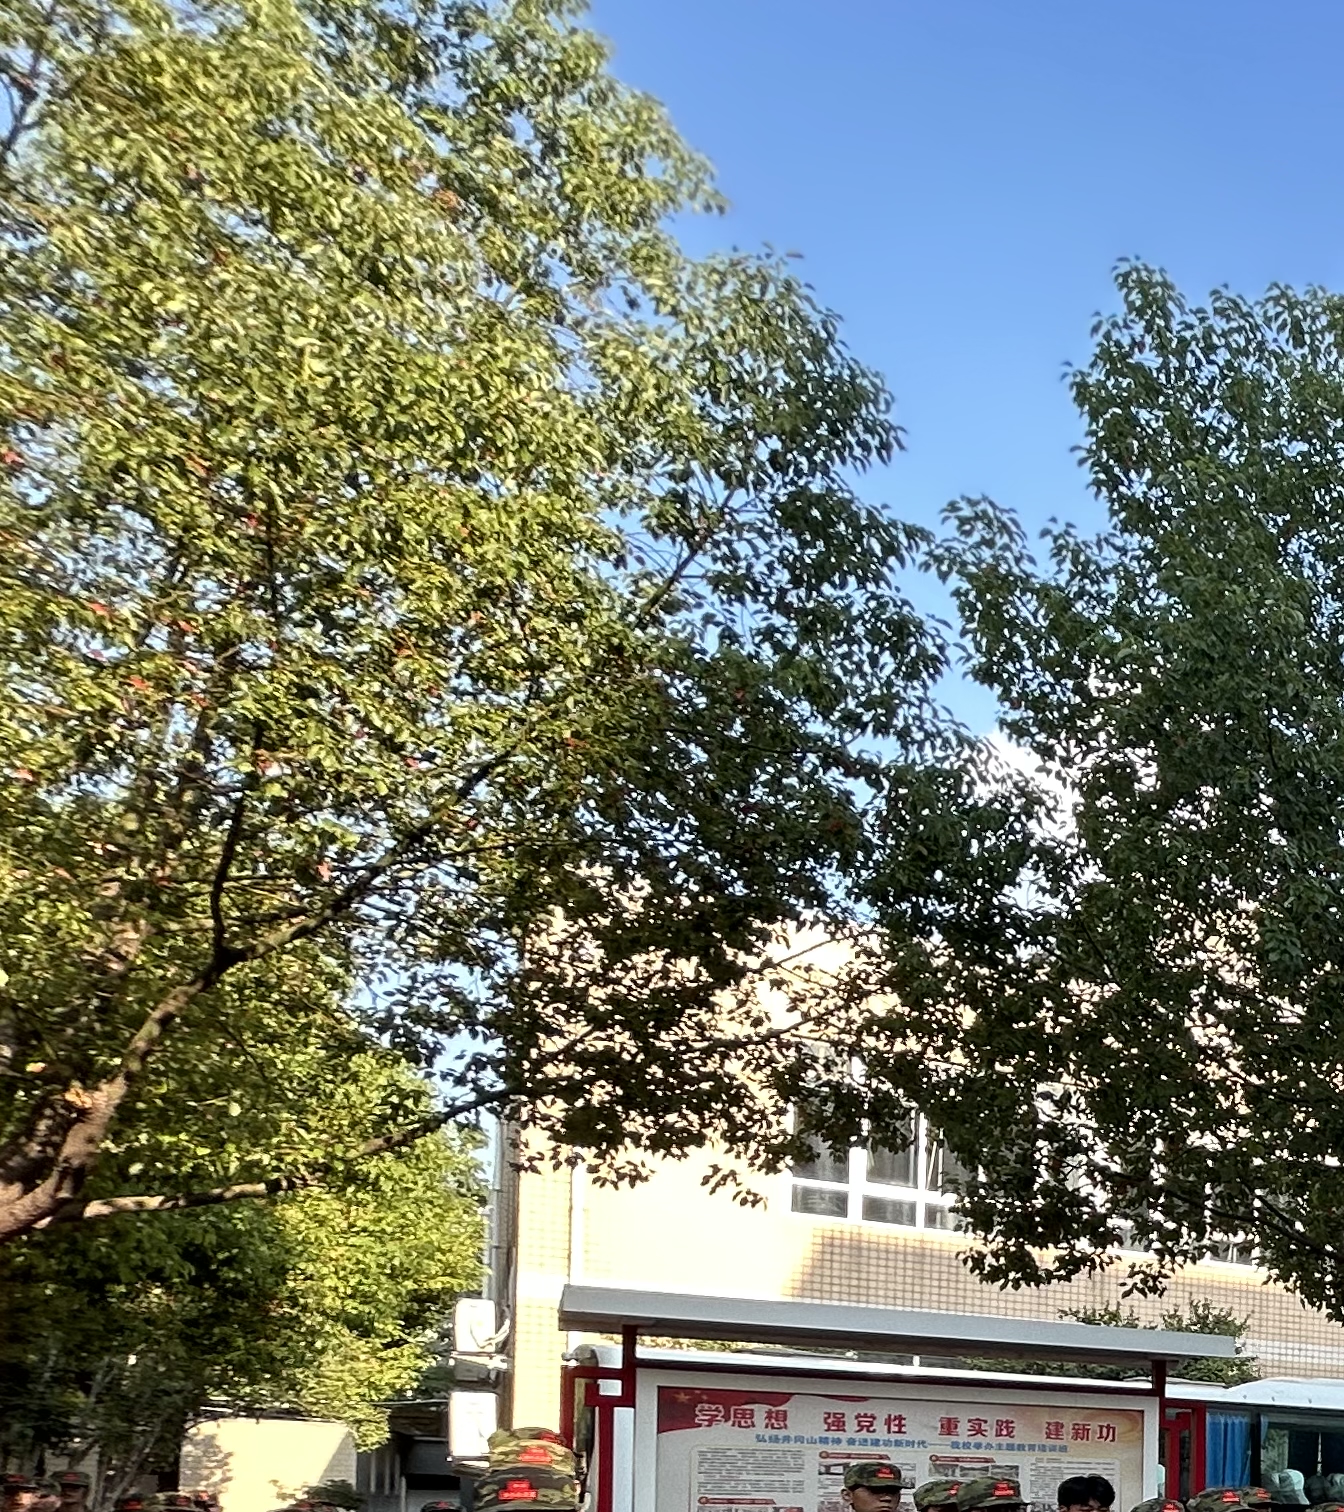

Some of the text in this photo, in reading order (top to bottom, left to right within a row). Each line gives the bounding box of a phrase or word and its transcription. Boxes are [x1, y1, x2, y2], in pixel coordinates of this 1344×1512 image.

[695, 1403, 1117, 1443] 学思想 强党性 重实践 建新功
